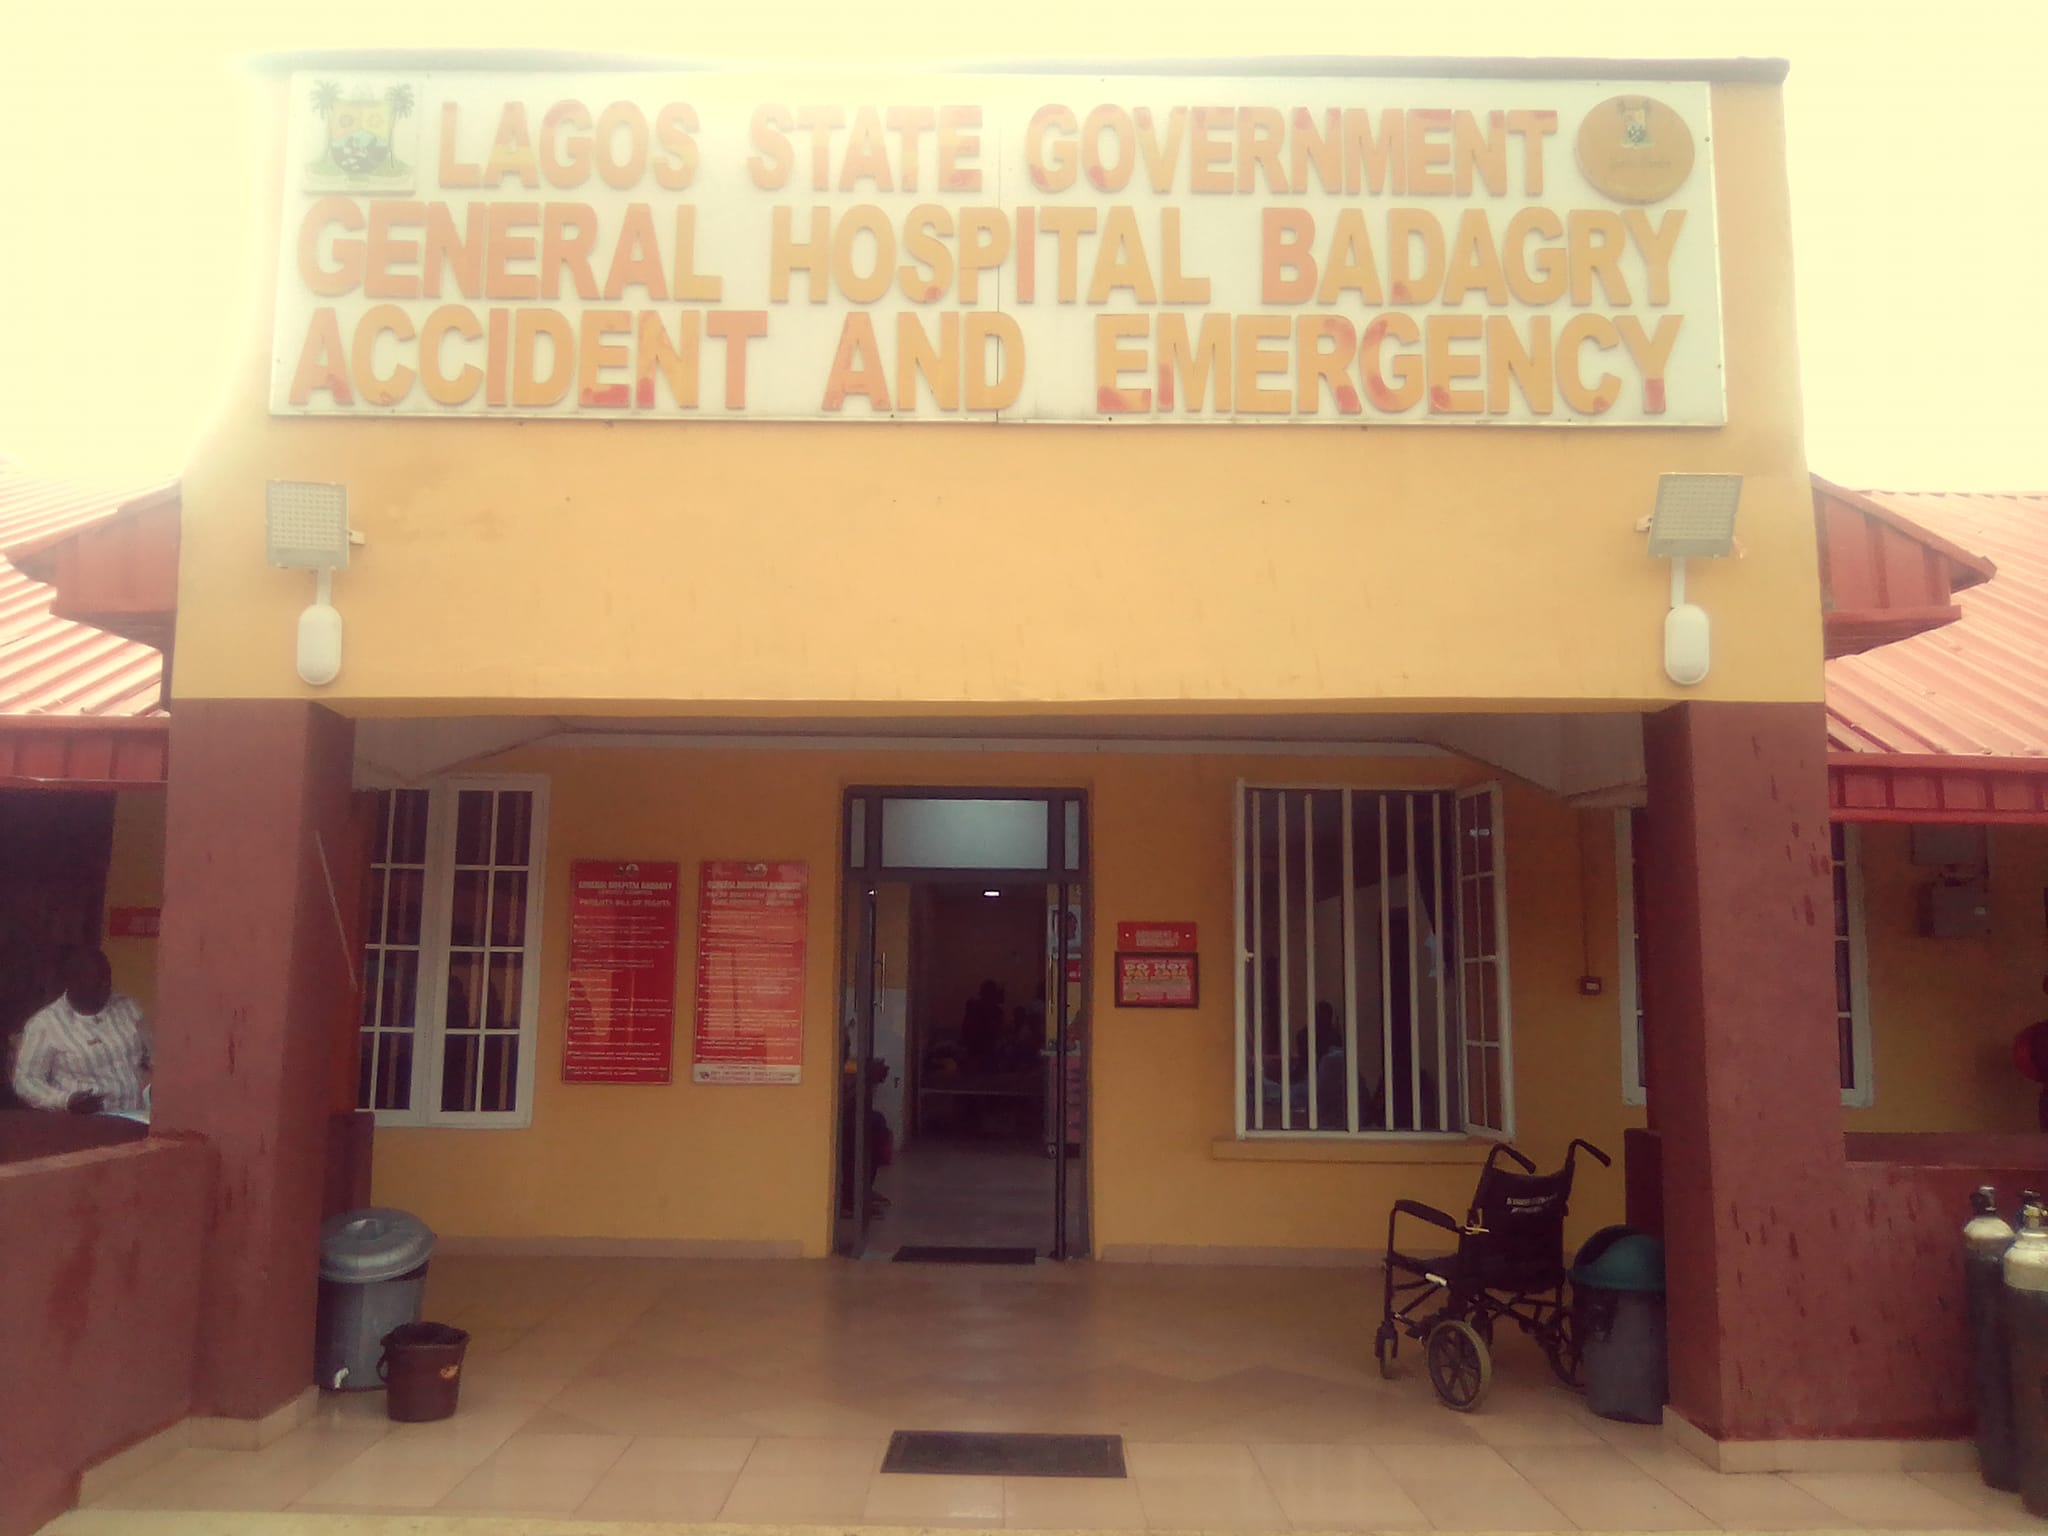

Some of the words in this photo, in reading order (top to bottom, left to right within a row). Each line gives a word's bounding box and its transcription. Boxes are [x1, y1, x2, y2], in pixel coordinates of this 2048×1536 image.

[438, 99, 699, 190] LAGOS
[746, 102, 983, 193] STATE
[1026, 103, 1558, 198] GOVERNMENT
[296, 197, 722, 301] GENERAL
[770, 203, 1211, 305] HOSPITAL
[1260, 206, 1688, 307] BADAGRY
[288, 304, 768, 409] ACCIDENT
[820, 309, 1026, 412] AND
[1096, 311, 1685, 415] EMERGENCY
